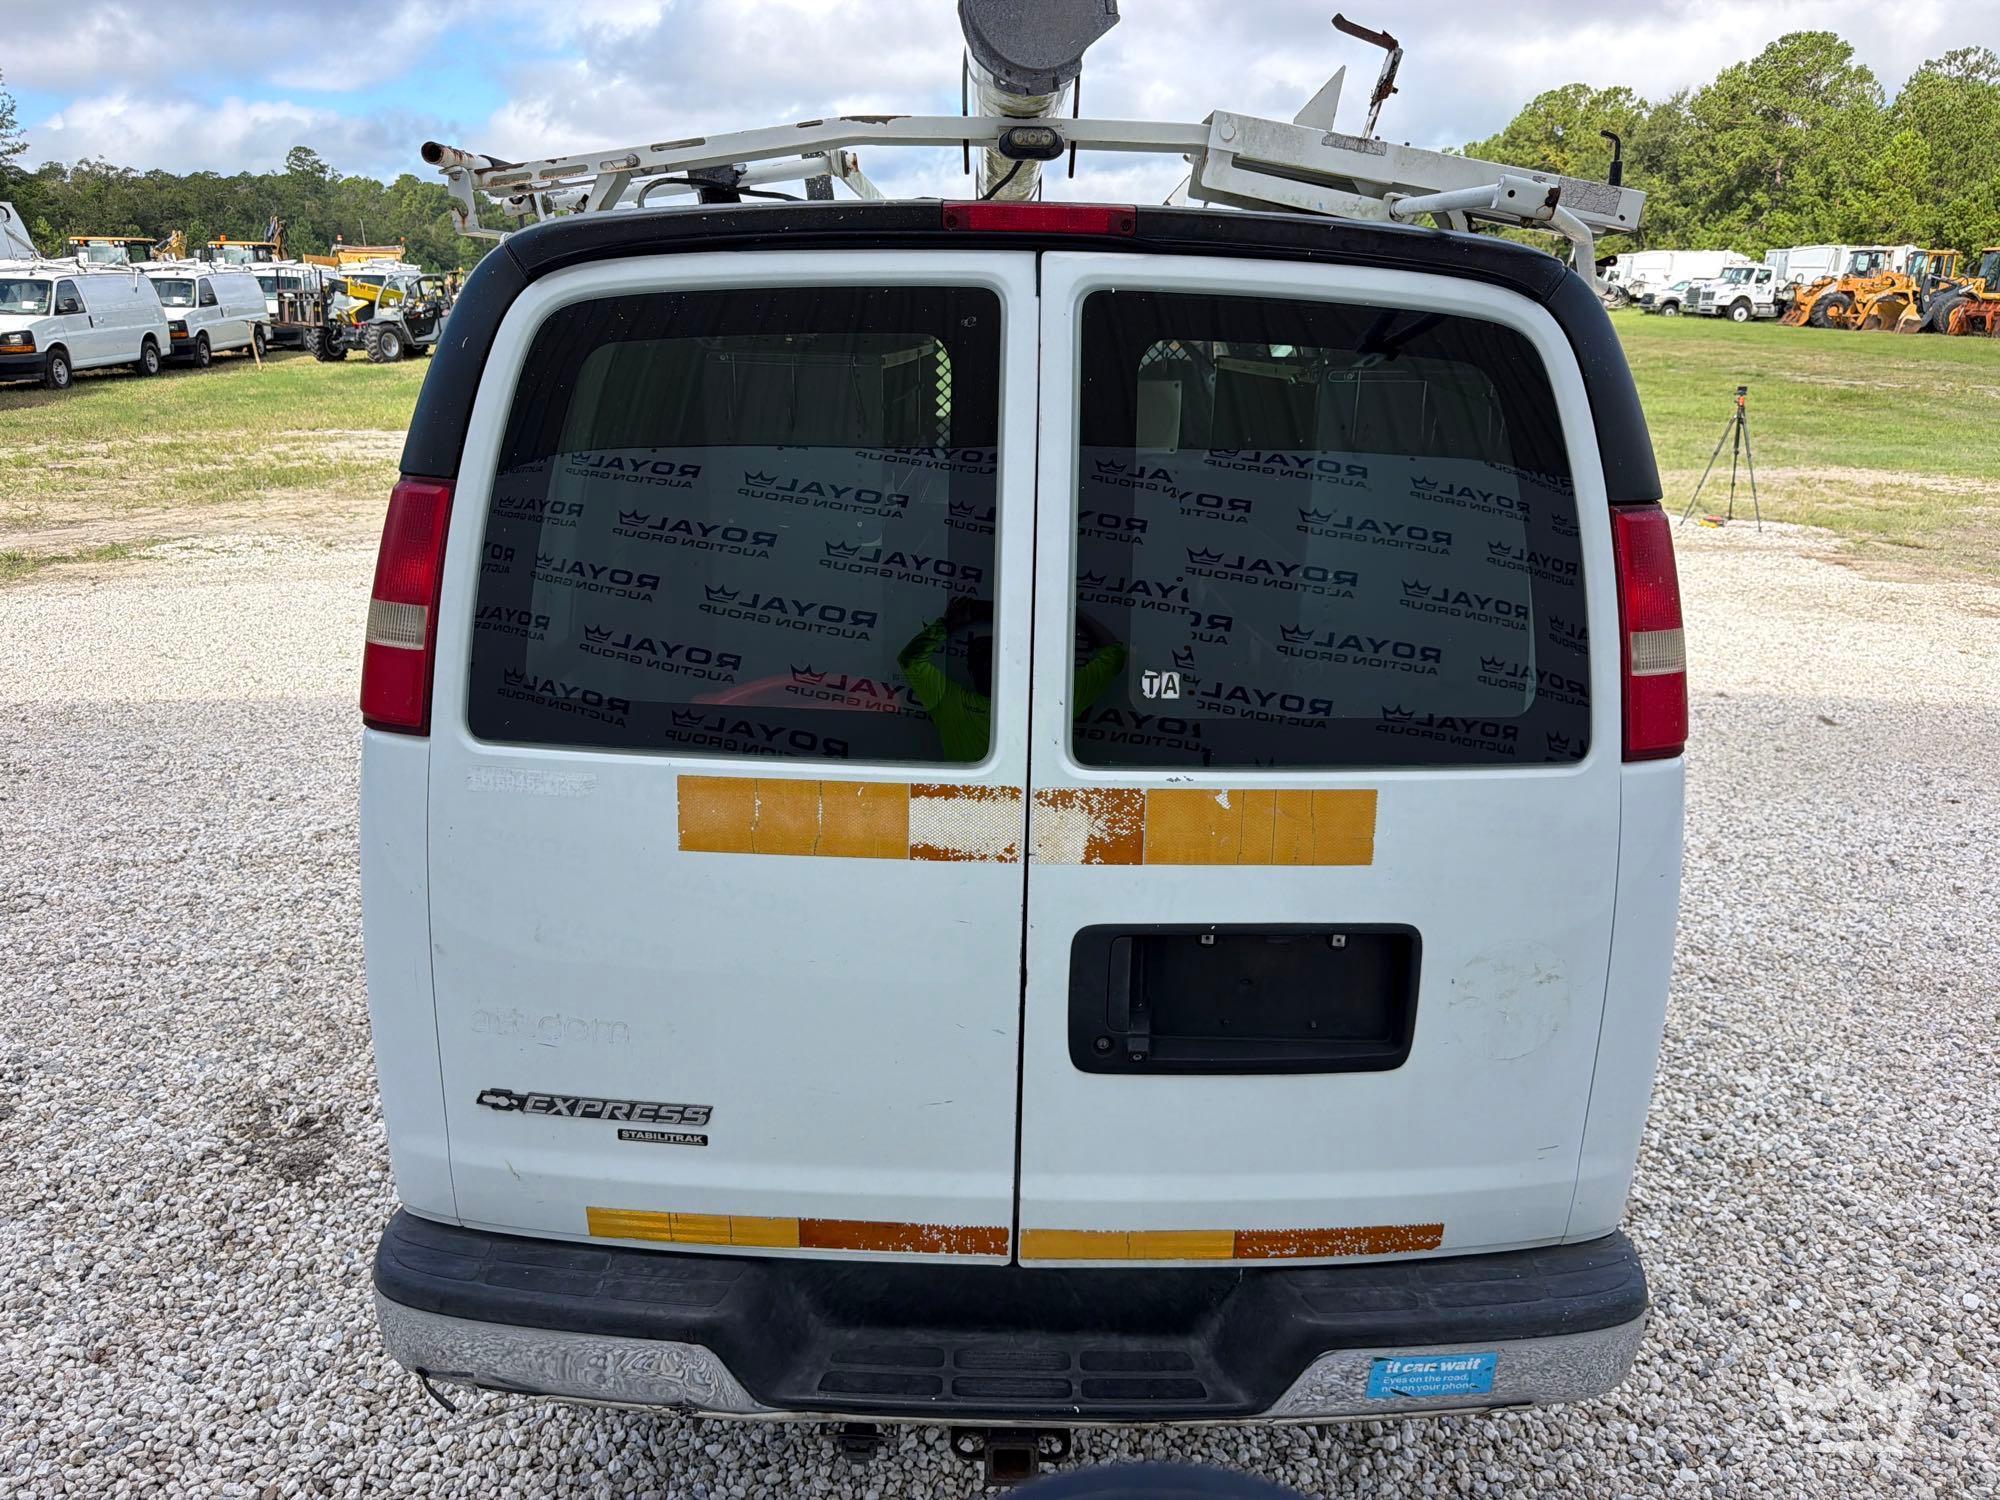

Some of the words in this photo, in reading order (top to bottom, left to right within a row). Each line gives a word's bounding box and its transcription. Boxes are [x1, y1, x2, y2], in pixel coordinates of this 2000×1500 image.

[1144, 674, 1177, 694] TA
[523, 1095, 711, 1125] EXPRESS
[621, 1130, 703, 1143] STABILITRAK
[1385, 1361, 1401, 1374] it
[1440, 1358, 1481, 1371] wait
[1383, 1376, 1408, 1385] Eyes
[1424, 1374, 1441, 1383] the
[1416, 1383, 1440, 1392] your
